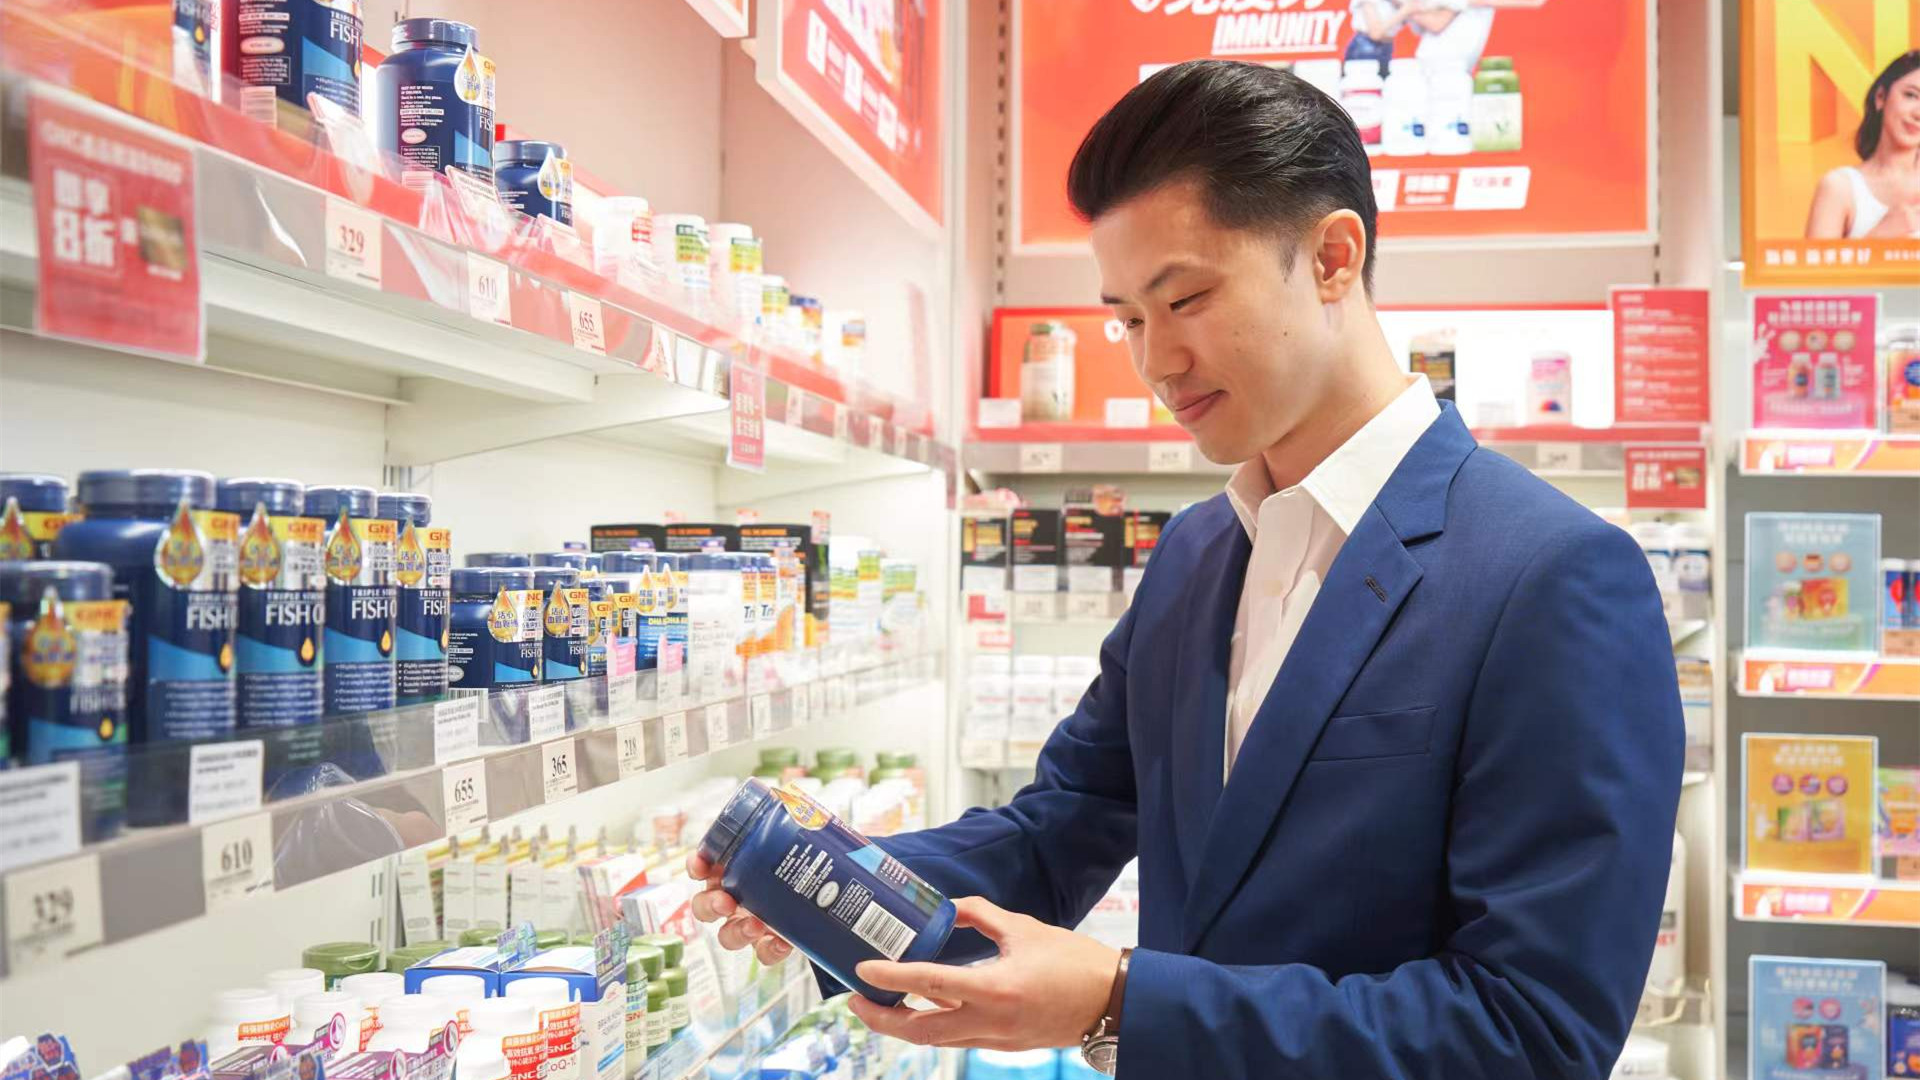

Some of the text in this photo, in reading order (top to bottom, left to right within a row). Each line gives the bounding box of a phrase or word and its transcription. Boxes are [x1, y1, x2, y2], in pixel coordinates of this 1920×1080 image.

[1212, 11, 1346, 48] IMMUNITY
[338, 224, 365, 254] 329
[578, 309, 596, 332] 655
[265, 603, 311, 626] FISH
[351, 599, 389, 620] FISH
[423, 600, 447, 616] FISH
[520, 648, 537, 659] FISH
[569, 647, 583, 656] FISH
[551, 754, 568, 777] 365
[454, 777, 475, 803] 655
[220, 838, 254, 873] 610
